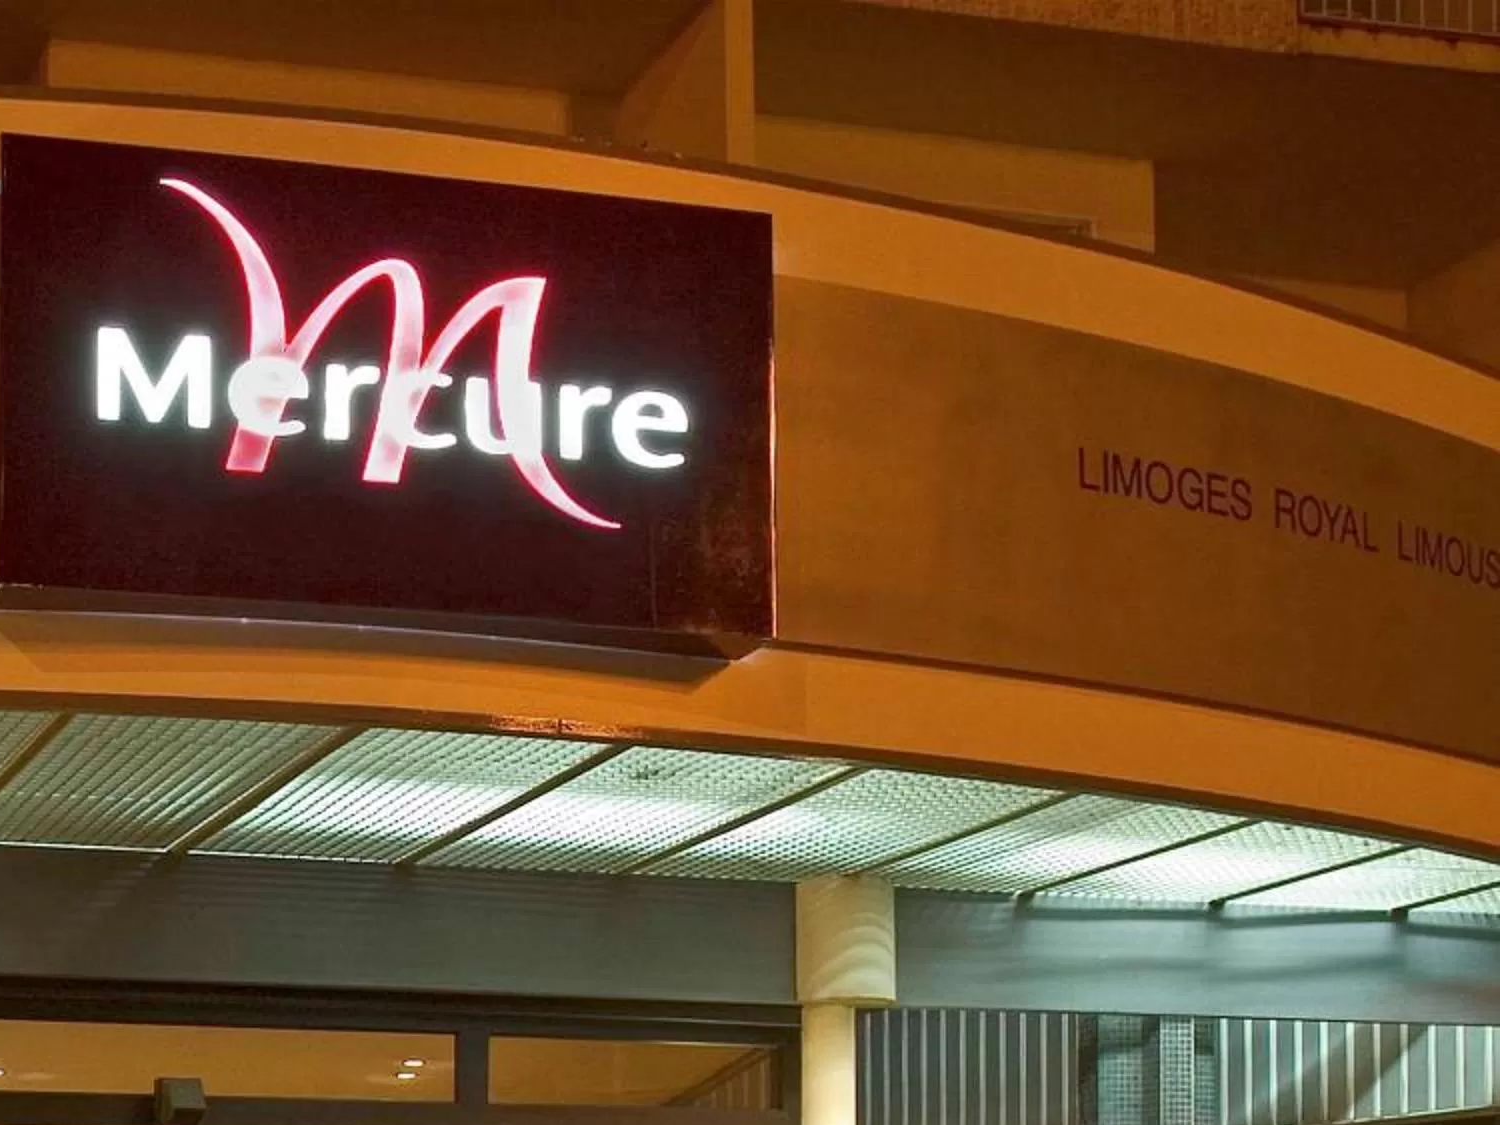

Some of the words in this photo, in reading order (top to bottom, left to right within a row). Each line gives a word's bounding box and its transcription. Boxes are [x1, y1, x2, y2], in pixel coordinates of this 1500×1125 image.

[95, 325, 690, 470] Mercure
[1078, 447, 1253, 521] LIMOGES
[1274, 487, 1380, 553] ROYAL
